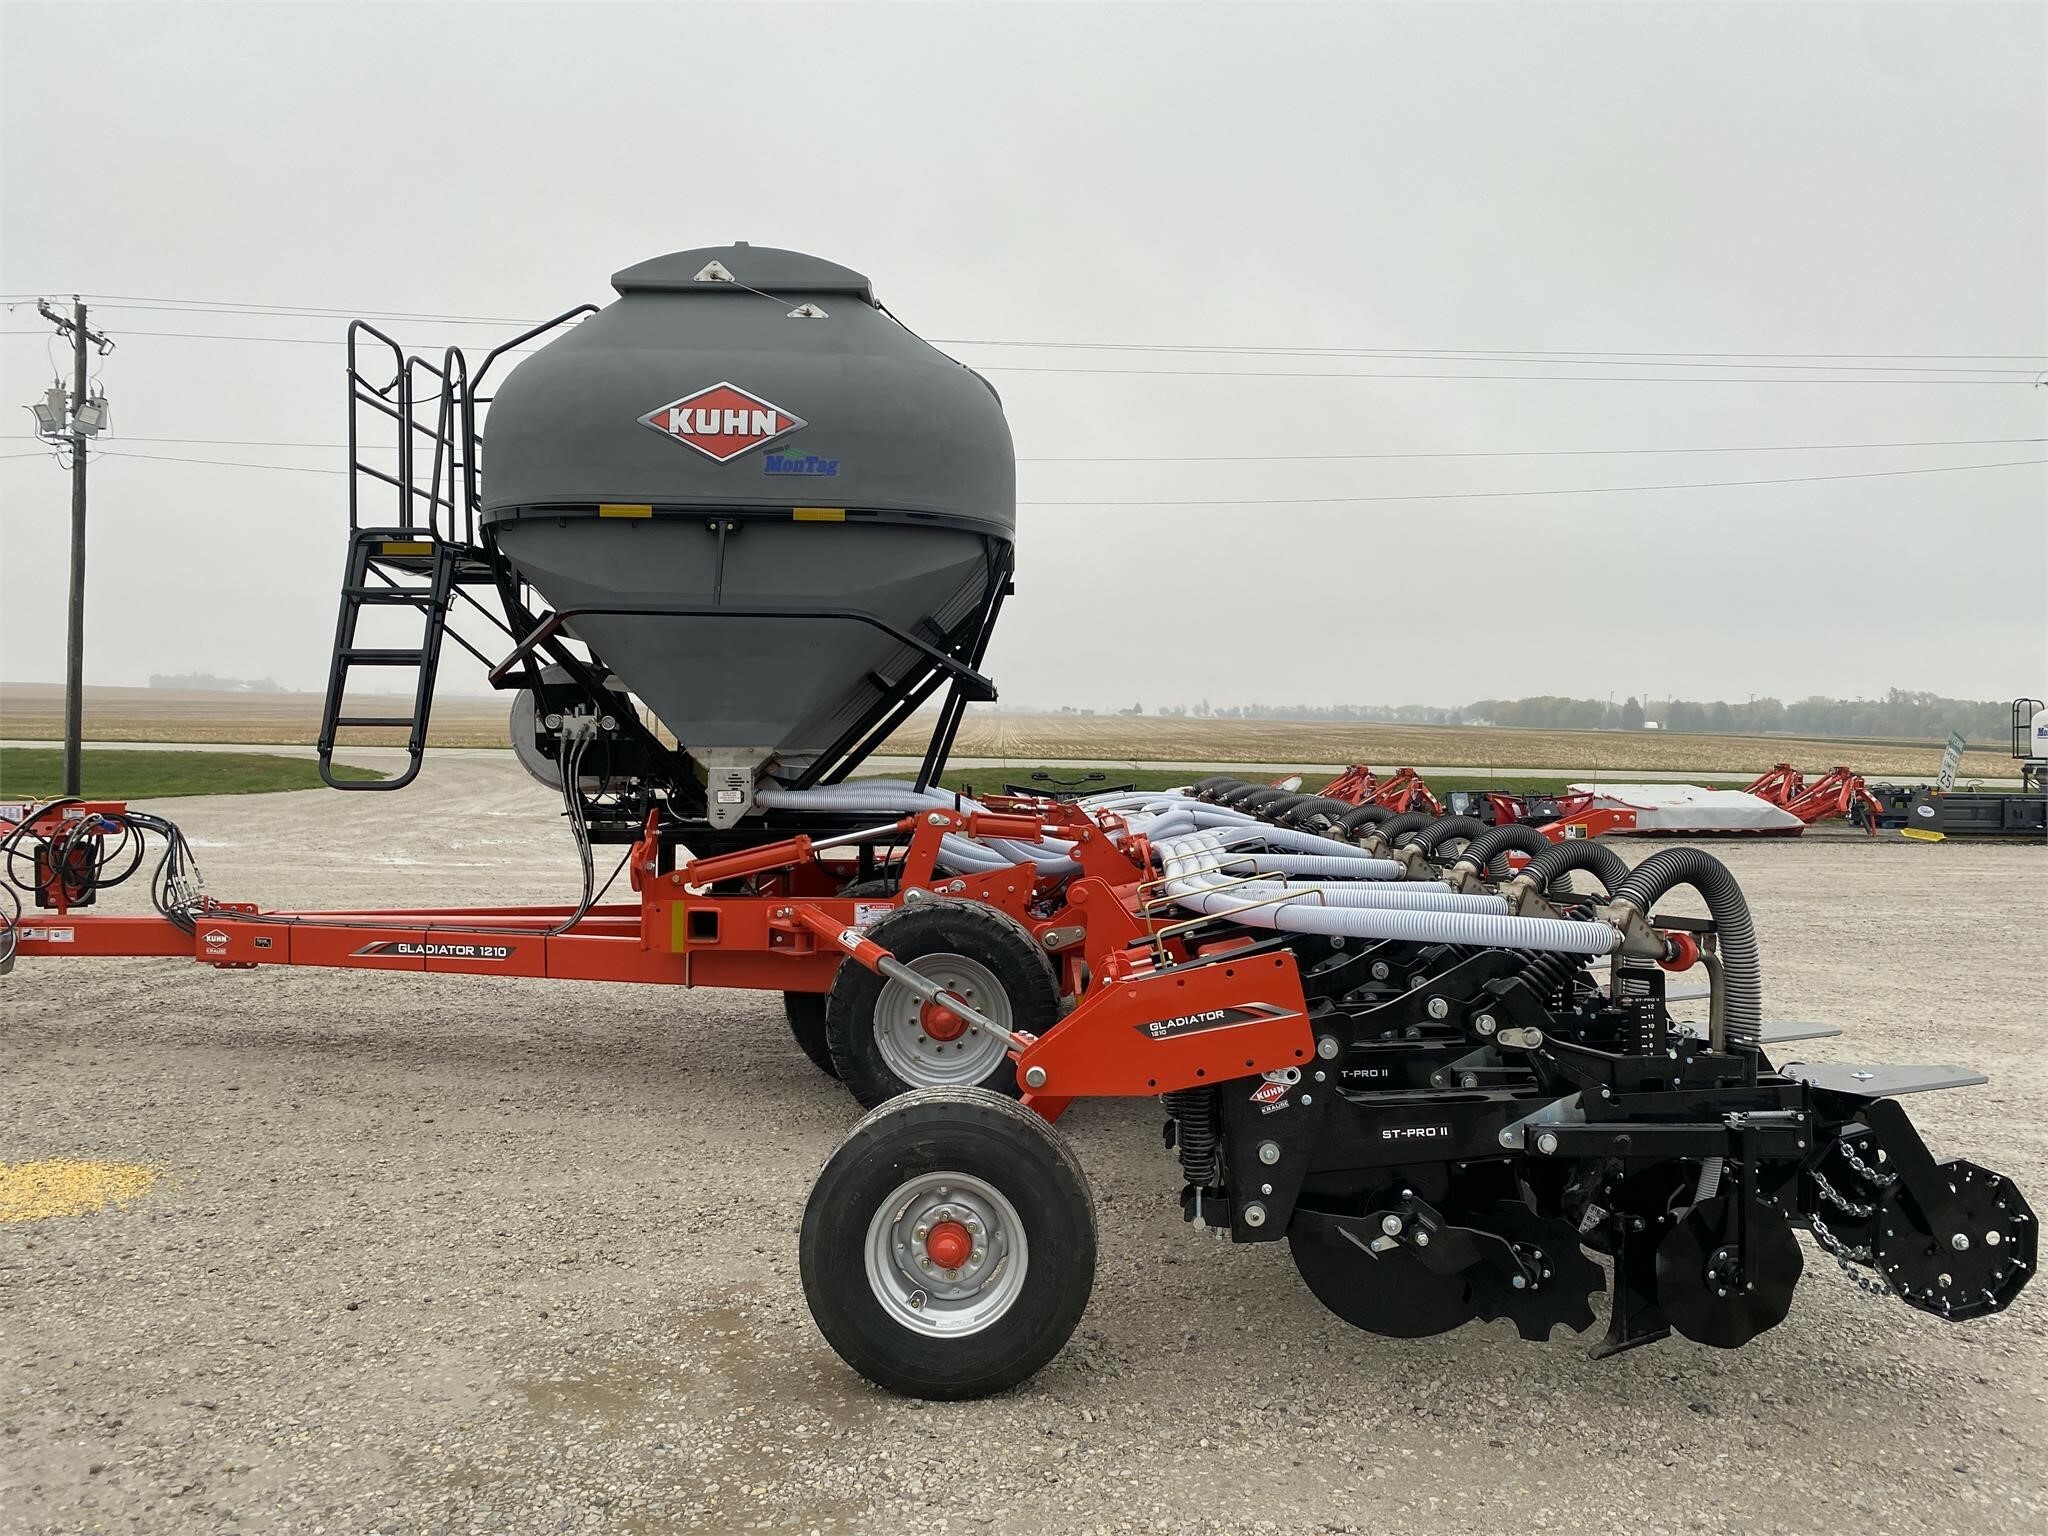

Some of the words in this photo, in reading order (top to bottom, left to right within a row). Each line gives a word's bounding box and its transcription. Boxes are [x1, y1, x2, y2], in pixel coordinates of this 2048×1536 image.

[668, 408, 776, 436] KUHN
[764, 455, 838, 476] MonTag
[1940, 770, 1952, 788] 25
[206, 935, 227, 943] KUHN
[398, 943, 475, 956] GLADIATOR
[479, 946, 507, 957] 1210
[1149, 1010, 1225, 1031] GLADIATOR
[1341, 1069, 1379, 1078] T-PRO
[1256, 1086, 1285, 1100] KUHN
[1261, 1101, 1289, 1114] KRAUSE
[1382, 1127, 1436, 1139] ST-PRO
[1440, 1127, 1448, 1136] II
